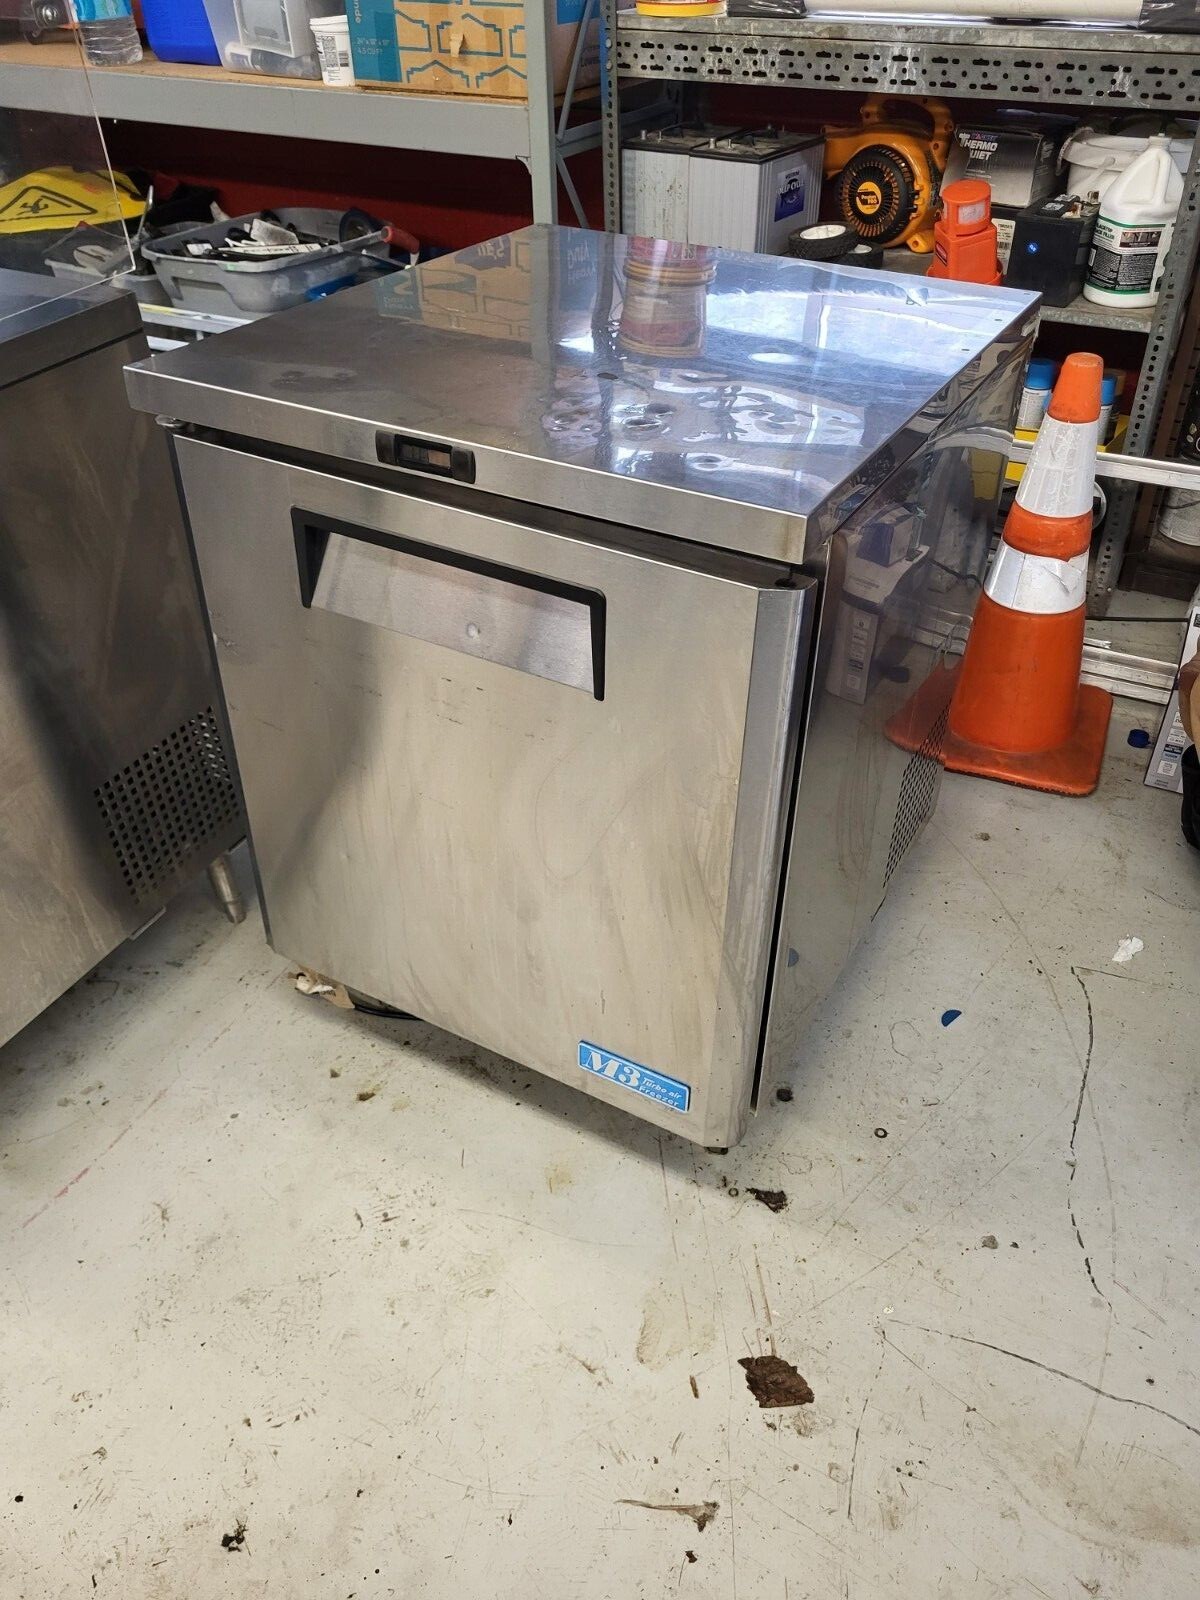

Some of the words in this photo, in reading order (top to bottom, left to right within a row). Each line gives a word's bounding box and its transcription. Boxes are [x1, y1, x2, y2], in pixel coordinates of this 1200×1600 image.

[959, 133, 999, 152] THERMO
[969, 149, 993, 161] UIET
[582, 1051, 641, 1087] M3
[639, 1086, 680, 1107] Freezer
[642, 1077, 667, 1093] Turbo
[669, 1091, 683, 1100] air
